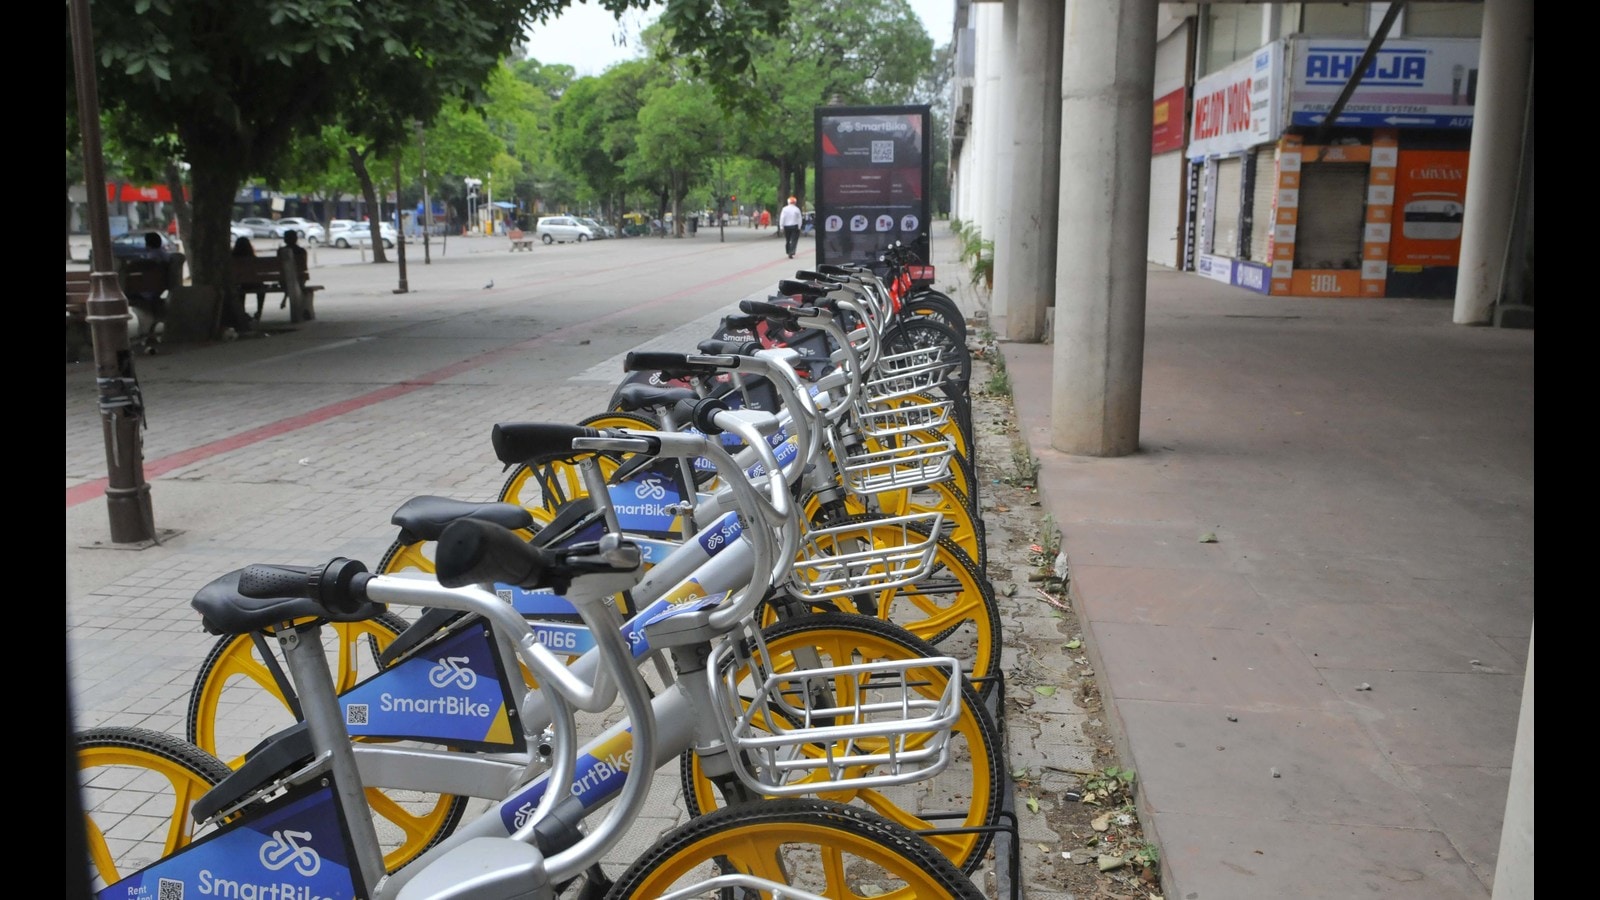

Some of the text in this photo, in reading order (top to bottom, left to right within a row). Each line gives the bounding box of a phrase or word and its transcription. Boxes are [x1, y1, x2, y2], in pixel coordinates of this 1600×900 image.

[1303, 104, 1334, 112] PUBLI
[1385, 105, 1428, 113] SYSTEMS
[855, 121, 907, 132] SmartBike
[1311, 274, 1342, 293] JBL
[535, 630, 577, 649] 0166
[380, 692, 490, 718] SmartBike
[570, 750, 633, 797] artBike
[127, 885, 148, 896] Rent
[197, 869, 333, 900] SmartBik
